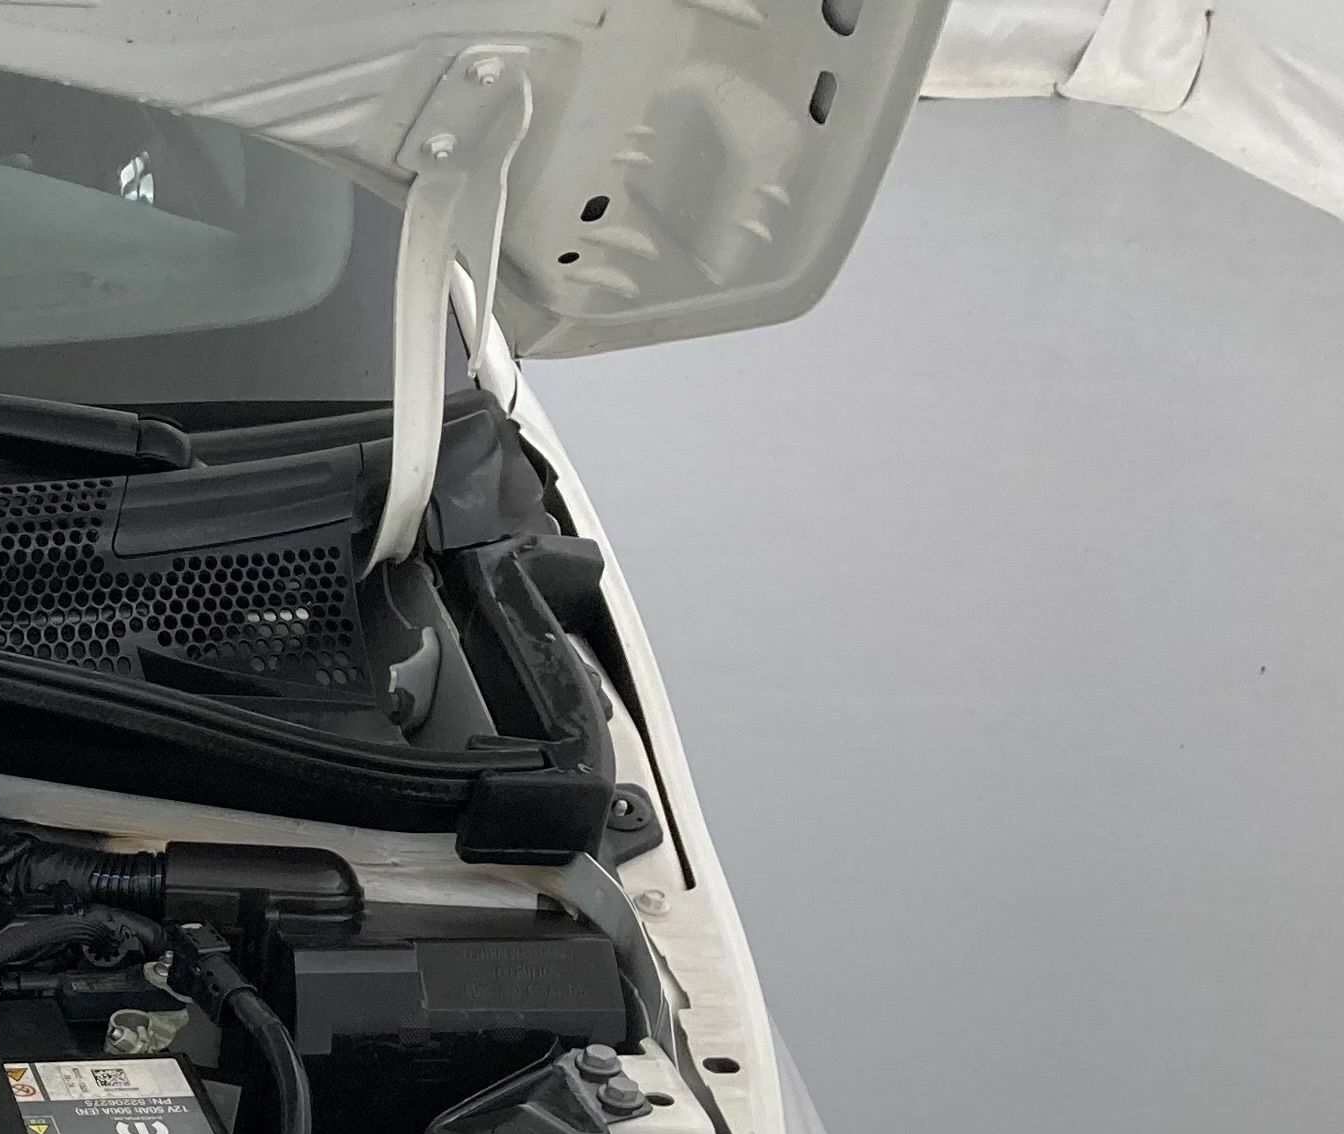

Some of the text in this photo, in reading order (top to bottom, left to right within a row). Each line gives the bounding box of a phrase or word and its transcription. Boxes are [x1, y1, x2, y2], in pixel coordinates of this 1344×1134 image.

[74, 1106, 100, 1117] (EN)
[134, 1105, 165, 1115] 50Ah
[167, 1104, 190, 1114] 12V
